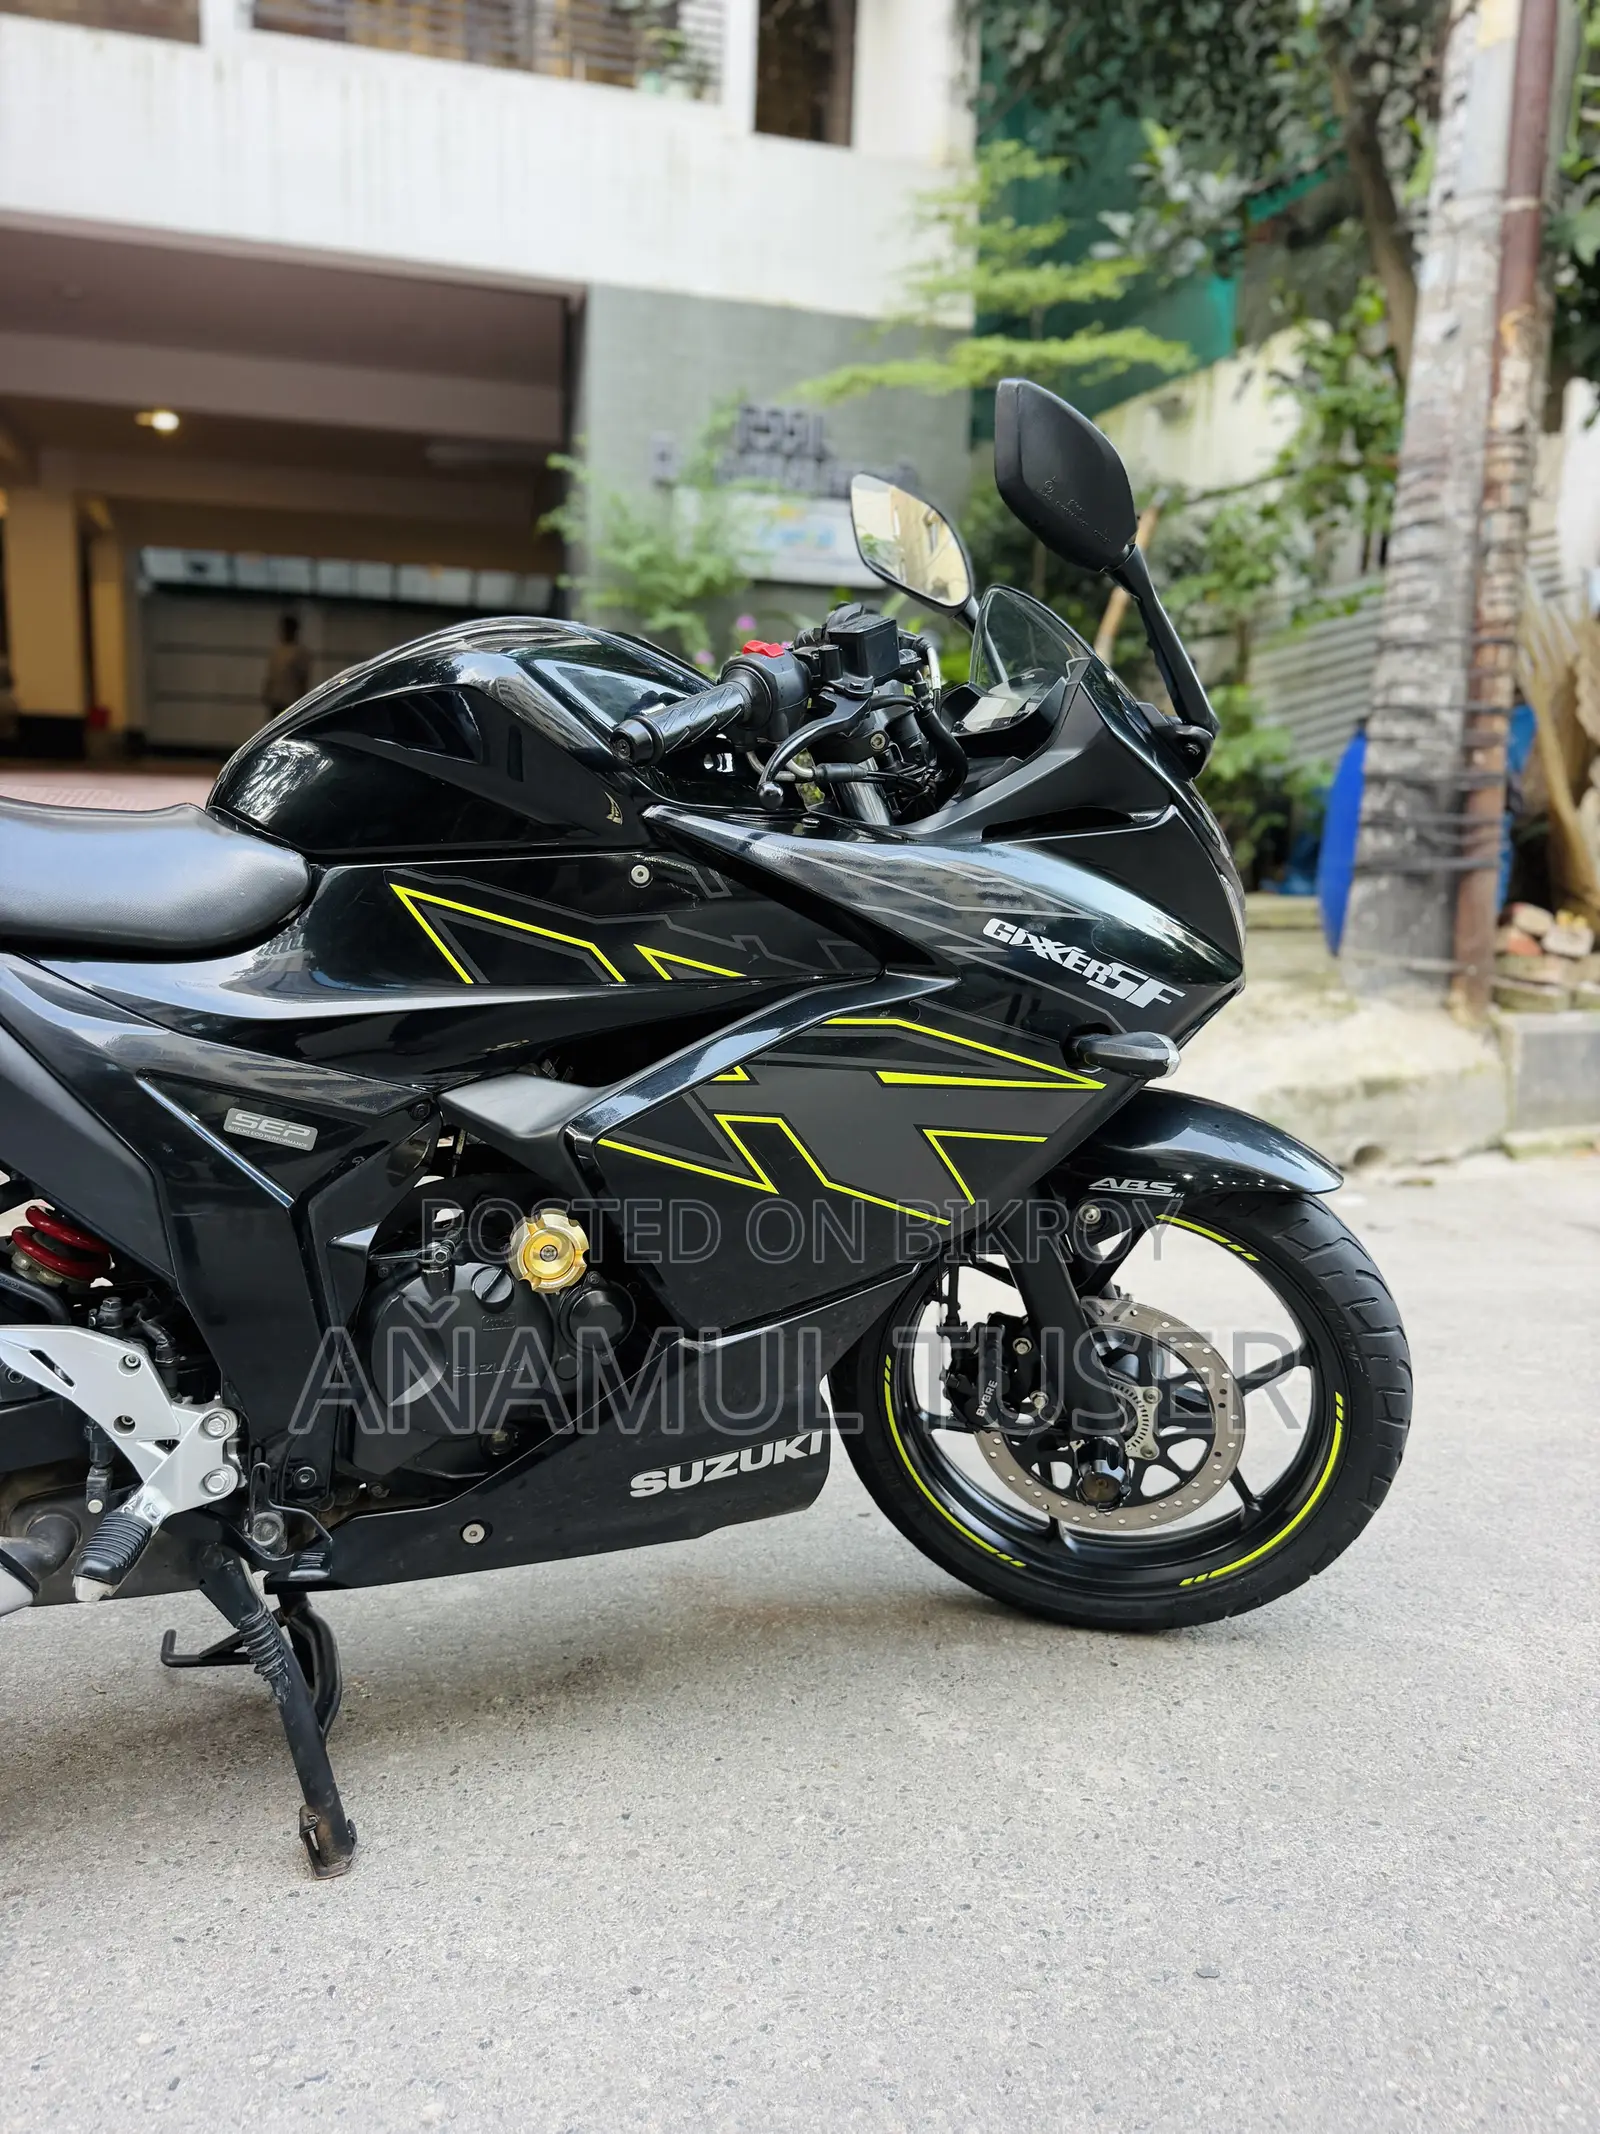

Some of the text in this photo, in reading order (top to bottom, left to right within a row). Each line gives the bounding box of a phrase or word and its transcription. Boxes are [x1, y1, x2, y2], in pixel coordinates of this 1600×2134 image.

[231, 1113, 311, 1137] SEP
[1089, 1177, 1180, 1195] ABS
[975, 1380, 998, 1417] BYBRE
[629, 1429, 824, 1498] SUZUKI
